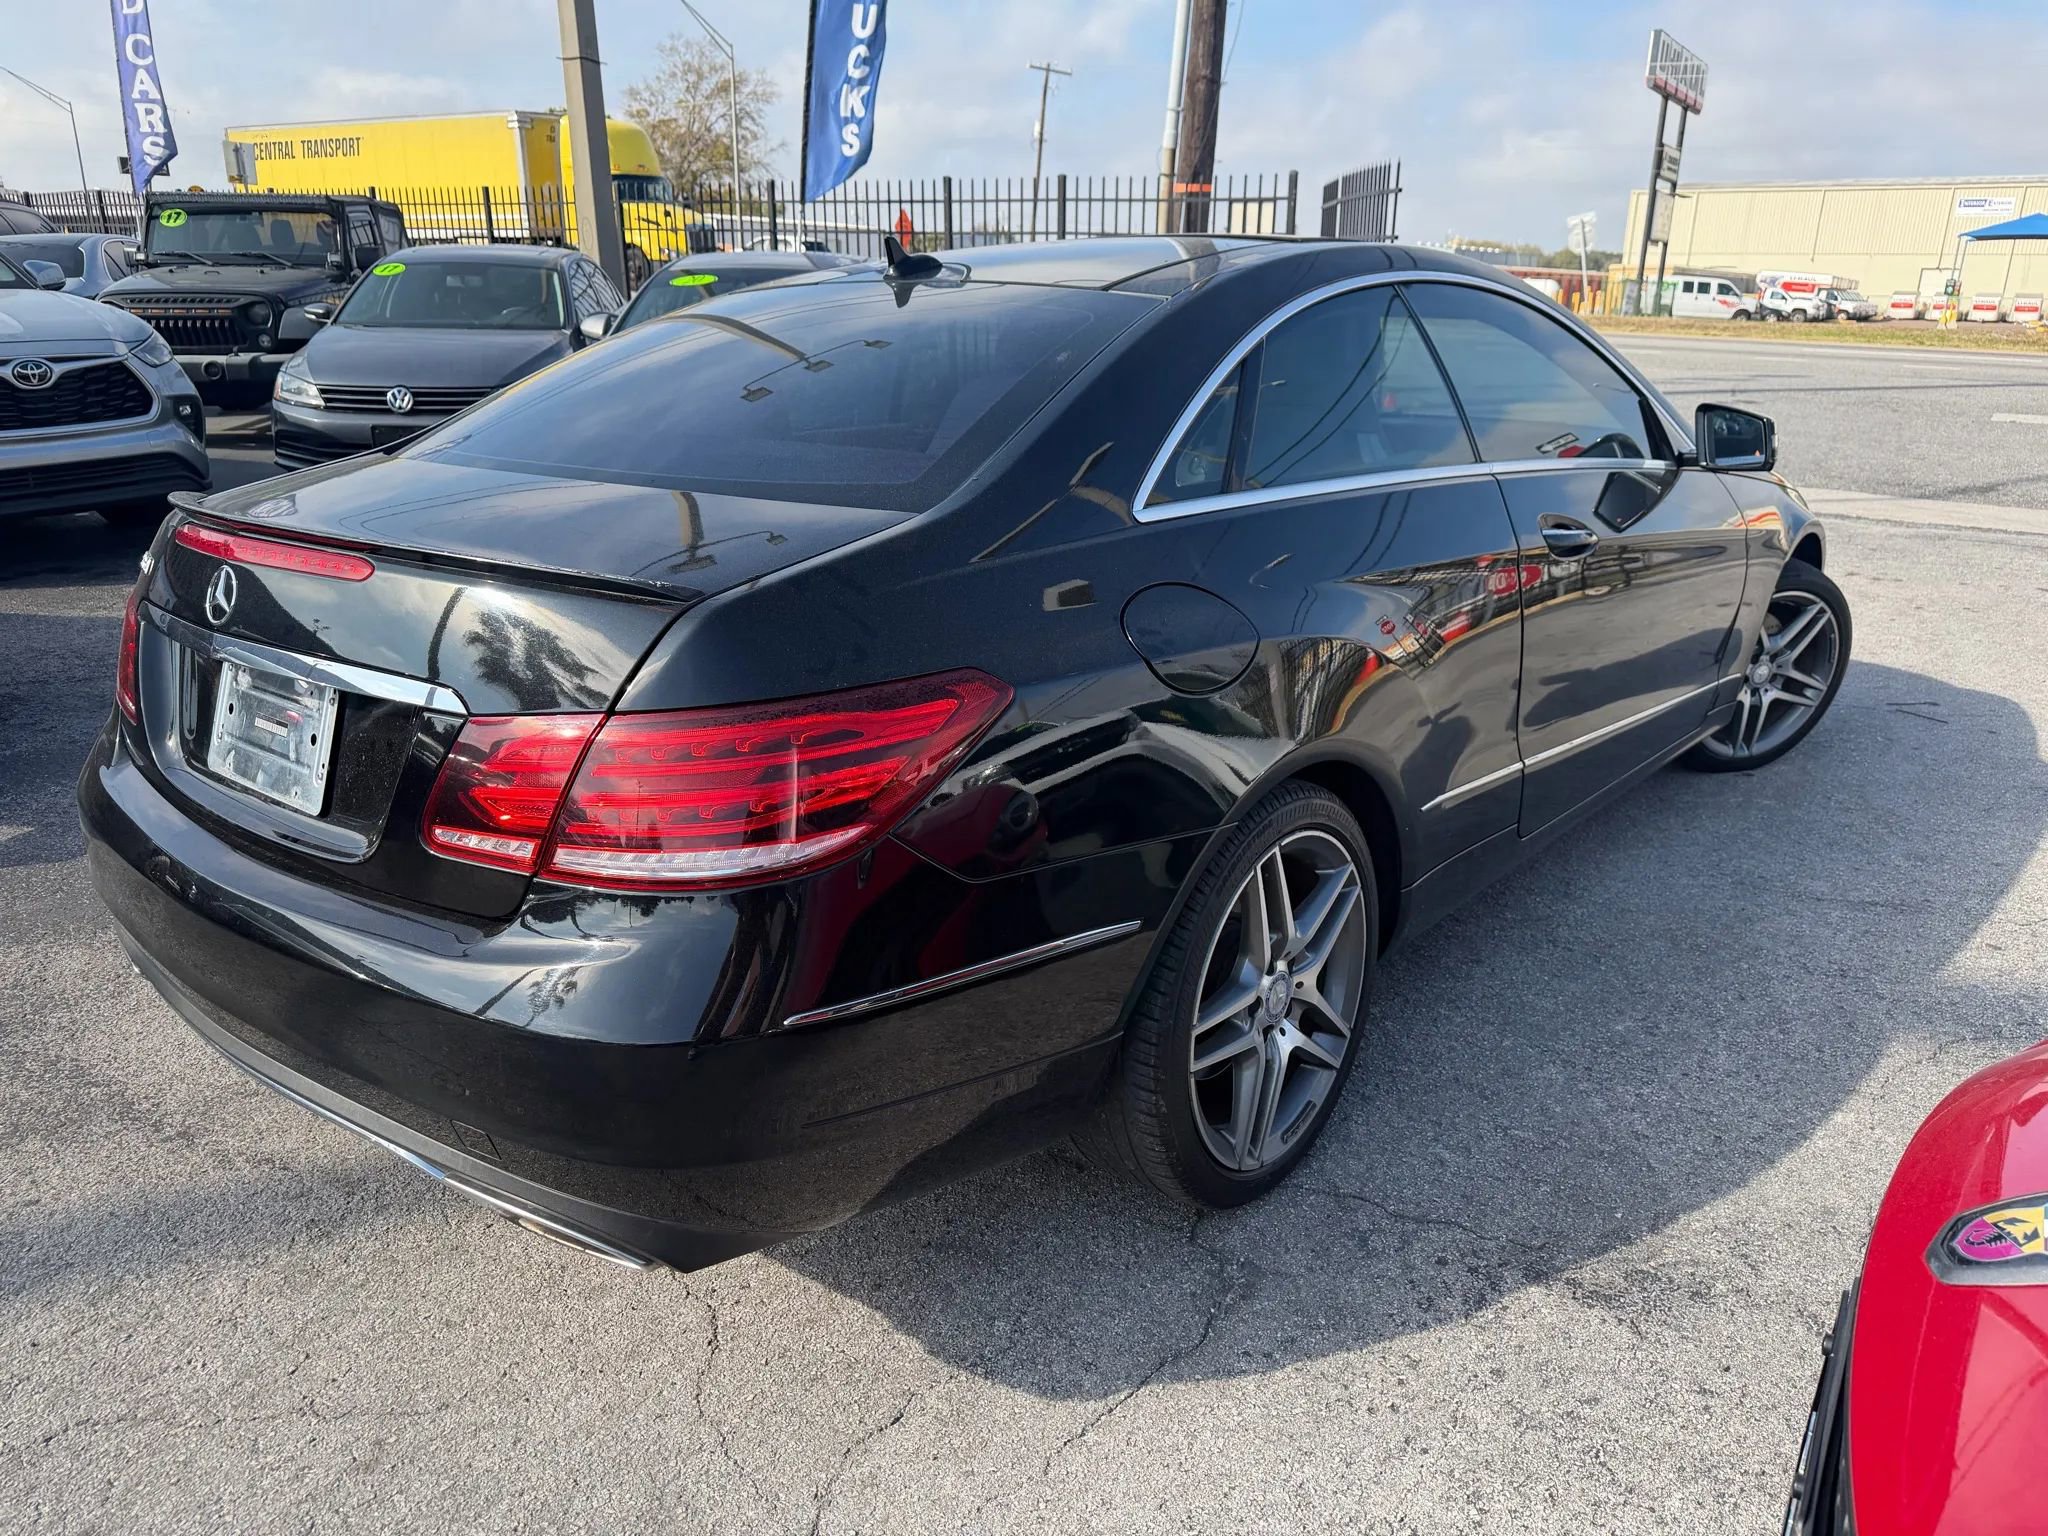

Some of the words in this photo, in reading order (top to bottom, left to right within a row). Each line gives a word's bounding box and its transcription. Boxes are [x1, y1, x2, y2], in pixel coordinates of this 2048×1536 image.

[125, 33, 167, 166] CARS
[839, 3, 878, 157] UCKS
[253, 140, 296, 161] CENTRAL
[300, 137, 361, 159] TRANSPORT
[165, 211, 182, 224] 17
